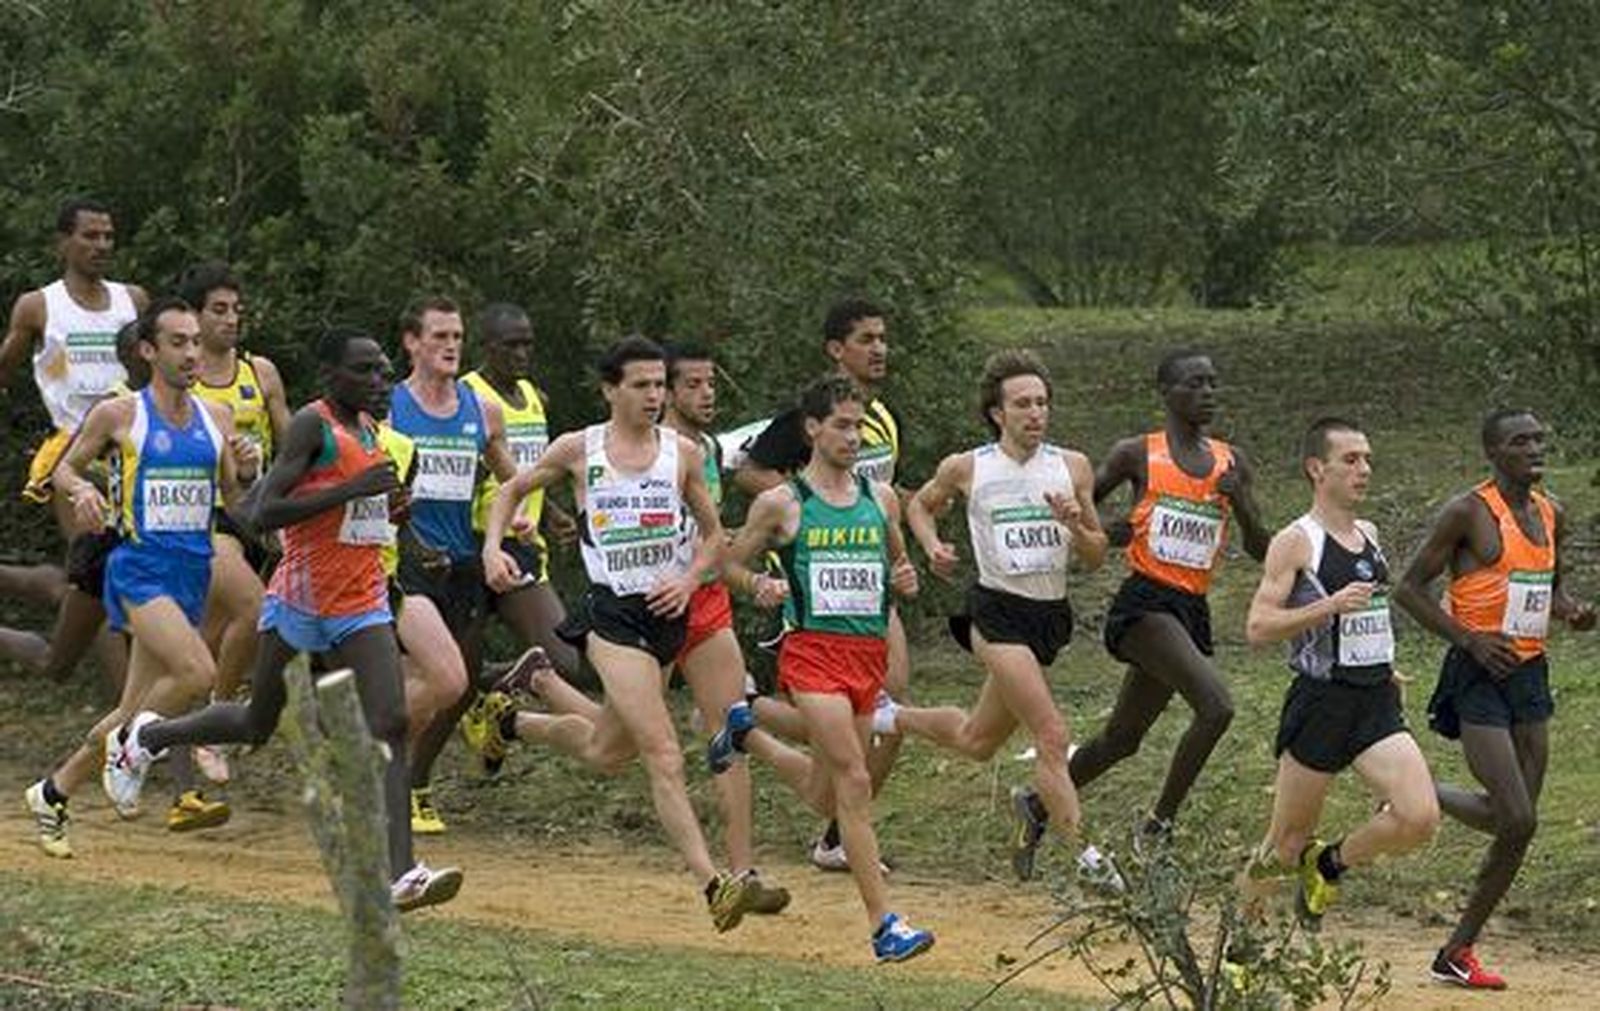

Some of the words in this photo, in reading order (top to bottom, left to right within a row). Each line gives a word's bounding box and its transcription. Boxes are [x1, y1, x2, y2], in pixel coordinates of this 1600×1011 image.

[417, 453, 474, 477] KINNER
[587, 465, 604, 487] P
[1004, 525, 1062, 550] GARCIA
[605, 542, 673, 572] HIGUERO
[819, 565, 880, 592] GUERRA
